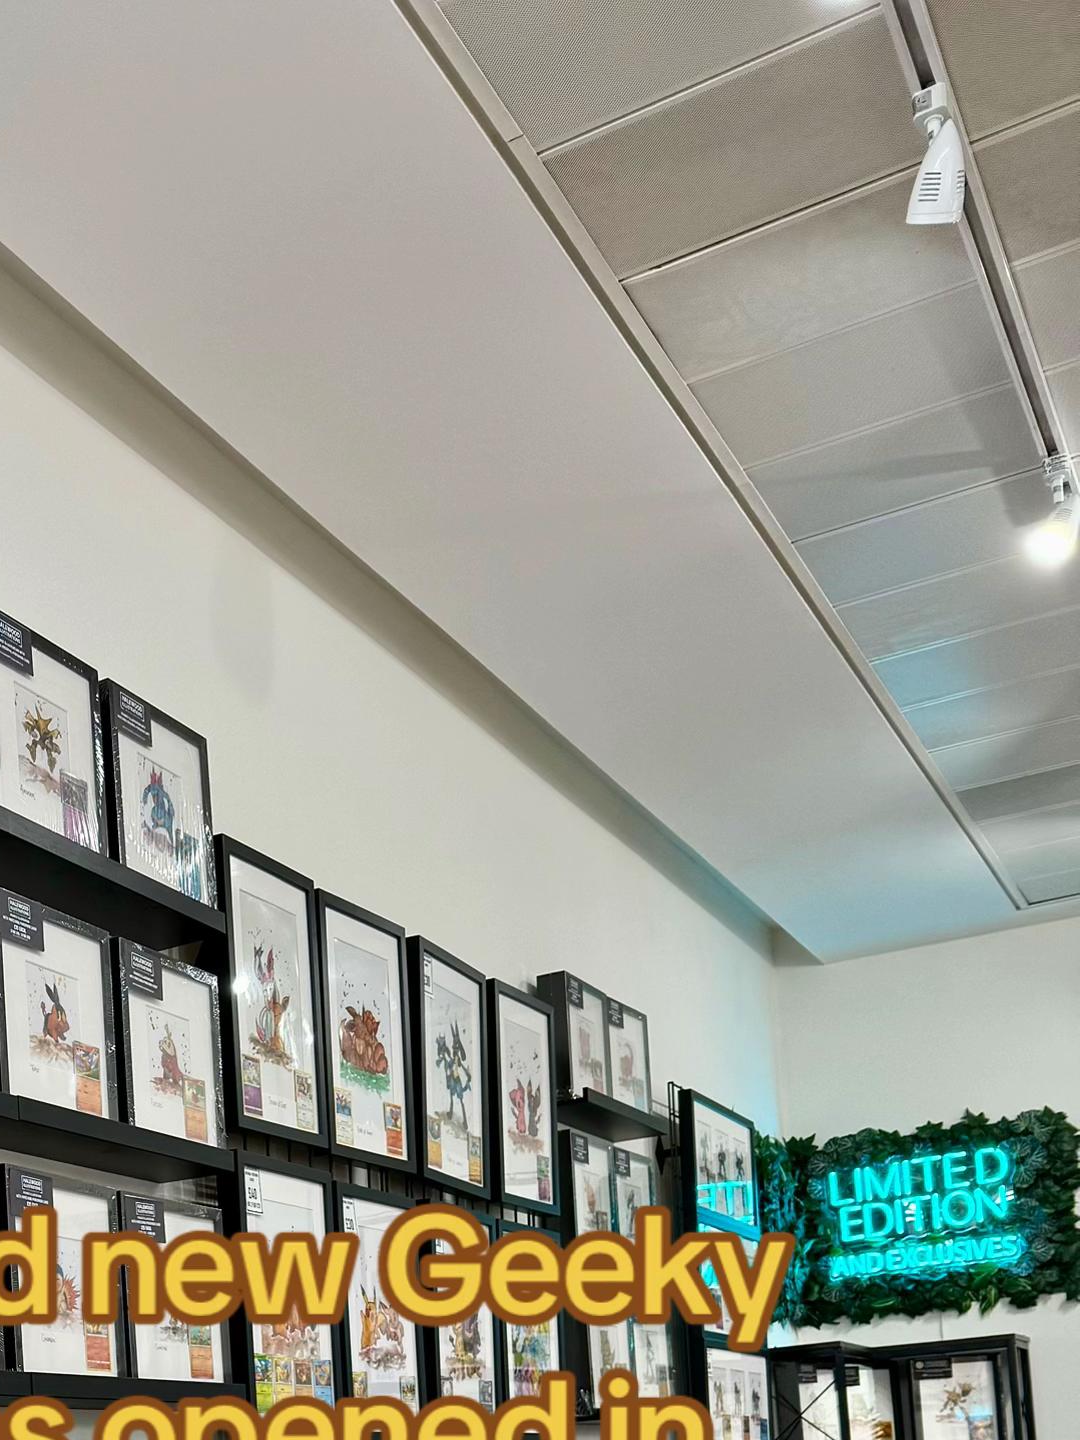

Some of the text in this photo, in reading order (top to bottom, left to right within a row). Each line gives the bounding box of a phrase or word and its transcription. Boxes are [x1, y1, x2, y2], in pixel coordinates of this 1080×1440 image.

[828, 1146, 1011, 1206] LIMITED
[839, 1184, 1010, 1244] EDITION
[830, 1234, 1021, 1281] AND EXCLUSIVES
